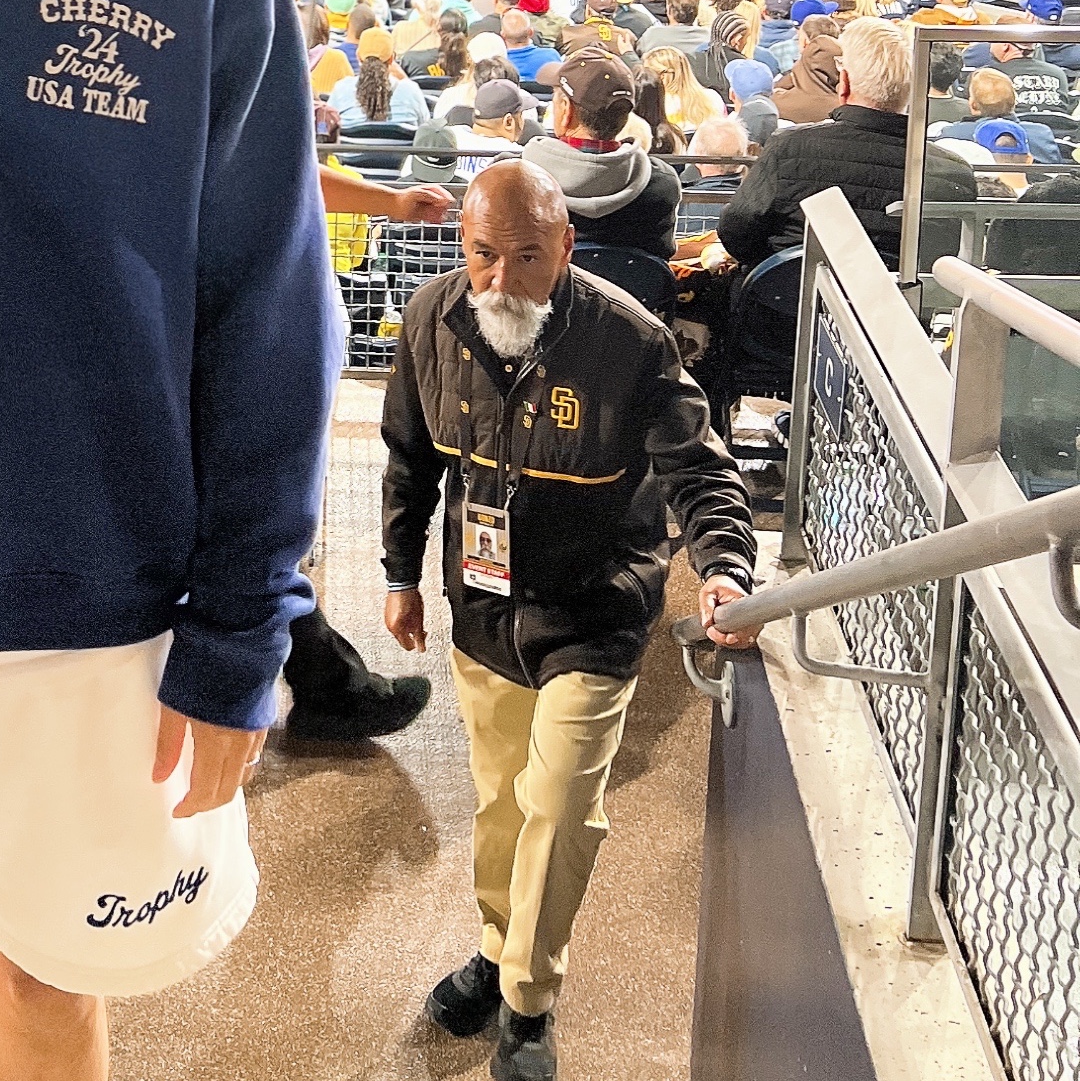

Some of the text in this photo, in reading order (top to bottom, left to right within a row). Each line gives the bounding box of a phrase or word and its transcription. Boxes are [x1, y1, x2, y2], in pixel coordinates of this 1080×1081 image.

[44, 43, 141, 96] Trophy
[26, 75, 150, 124] USA TEAM
[824, 356, 834, 398] C
[550, 386, 580, 430] SD
[86, 866, 209, 928] Trophy
